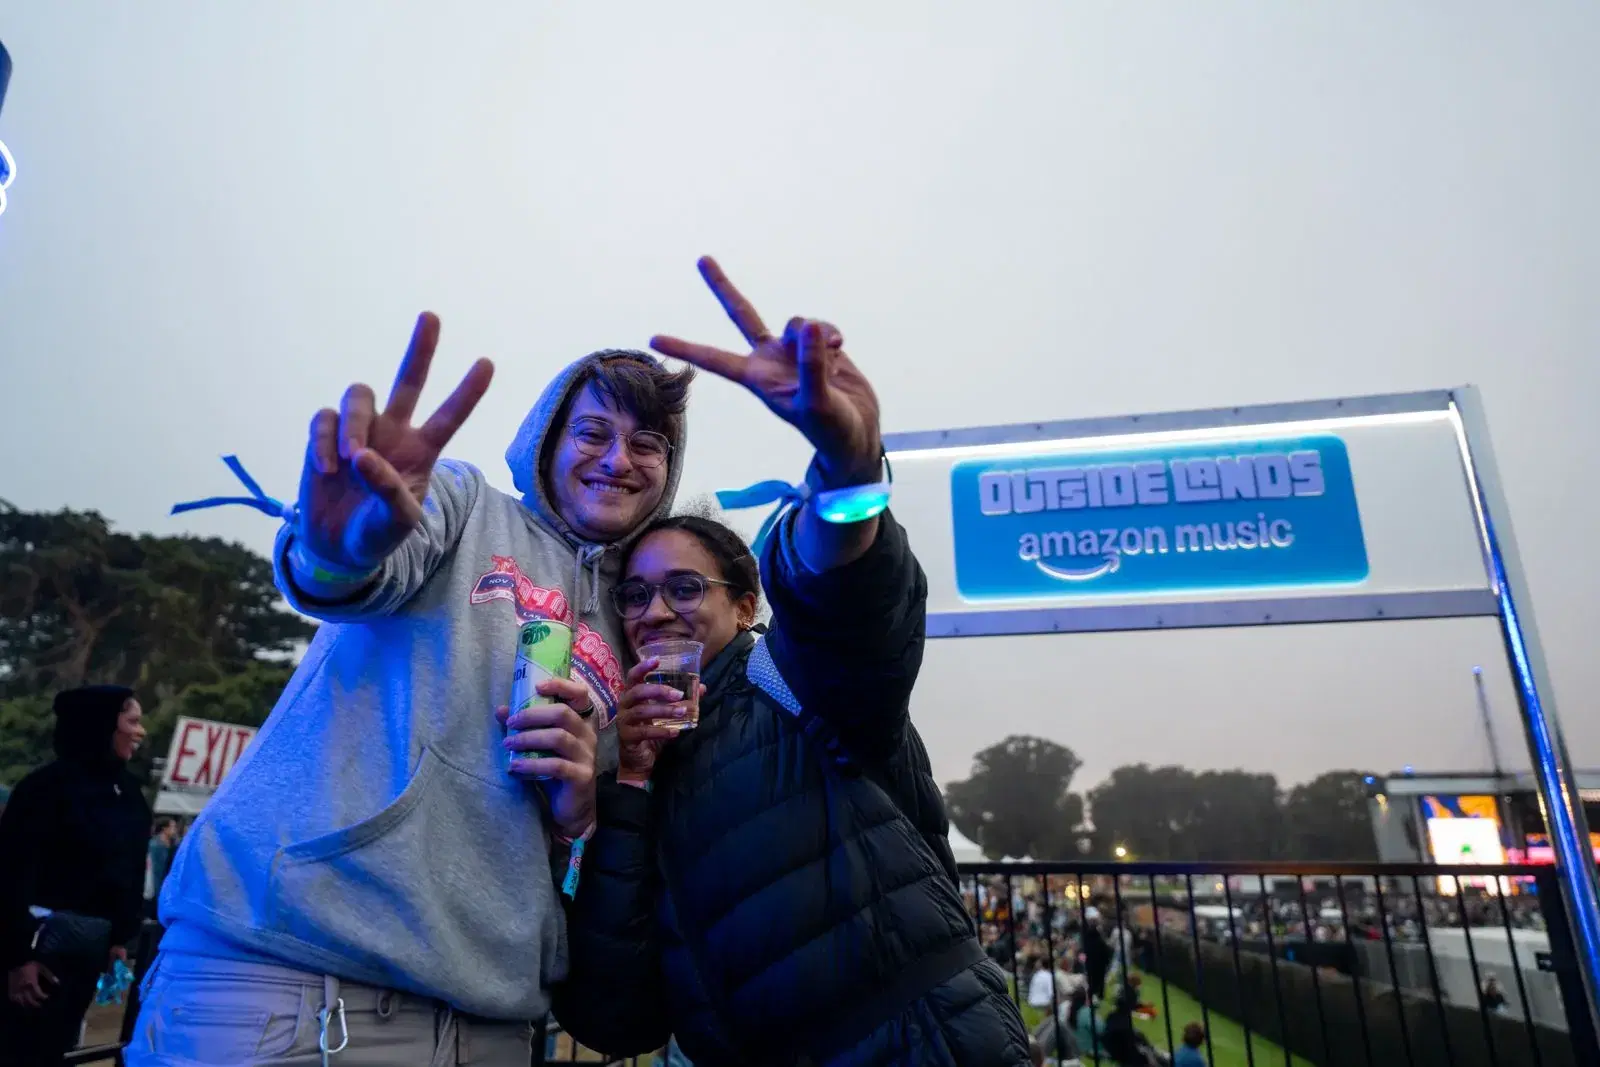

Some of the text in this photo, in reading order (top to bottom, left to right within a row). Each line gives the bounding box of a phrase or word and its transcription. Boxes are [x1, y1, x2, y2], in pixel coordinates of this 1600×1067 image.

[979, 460, 1169, 515] OUTSIDE
[1018, 512, 1296, 561] amazon music
[170, 720, 251, 785] EXIT
